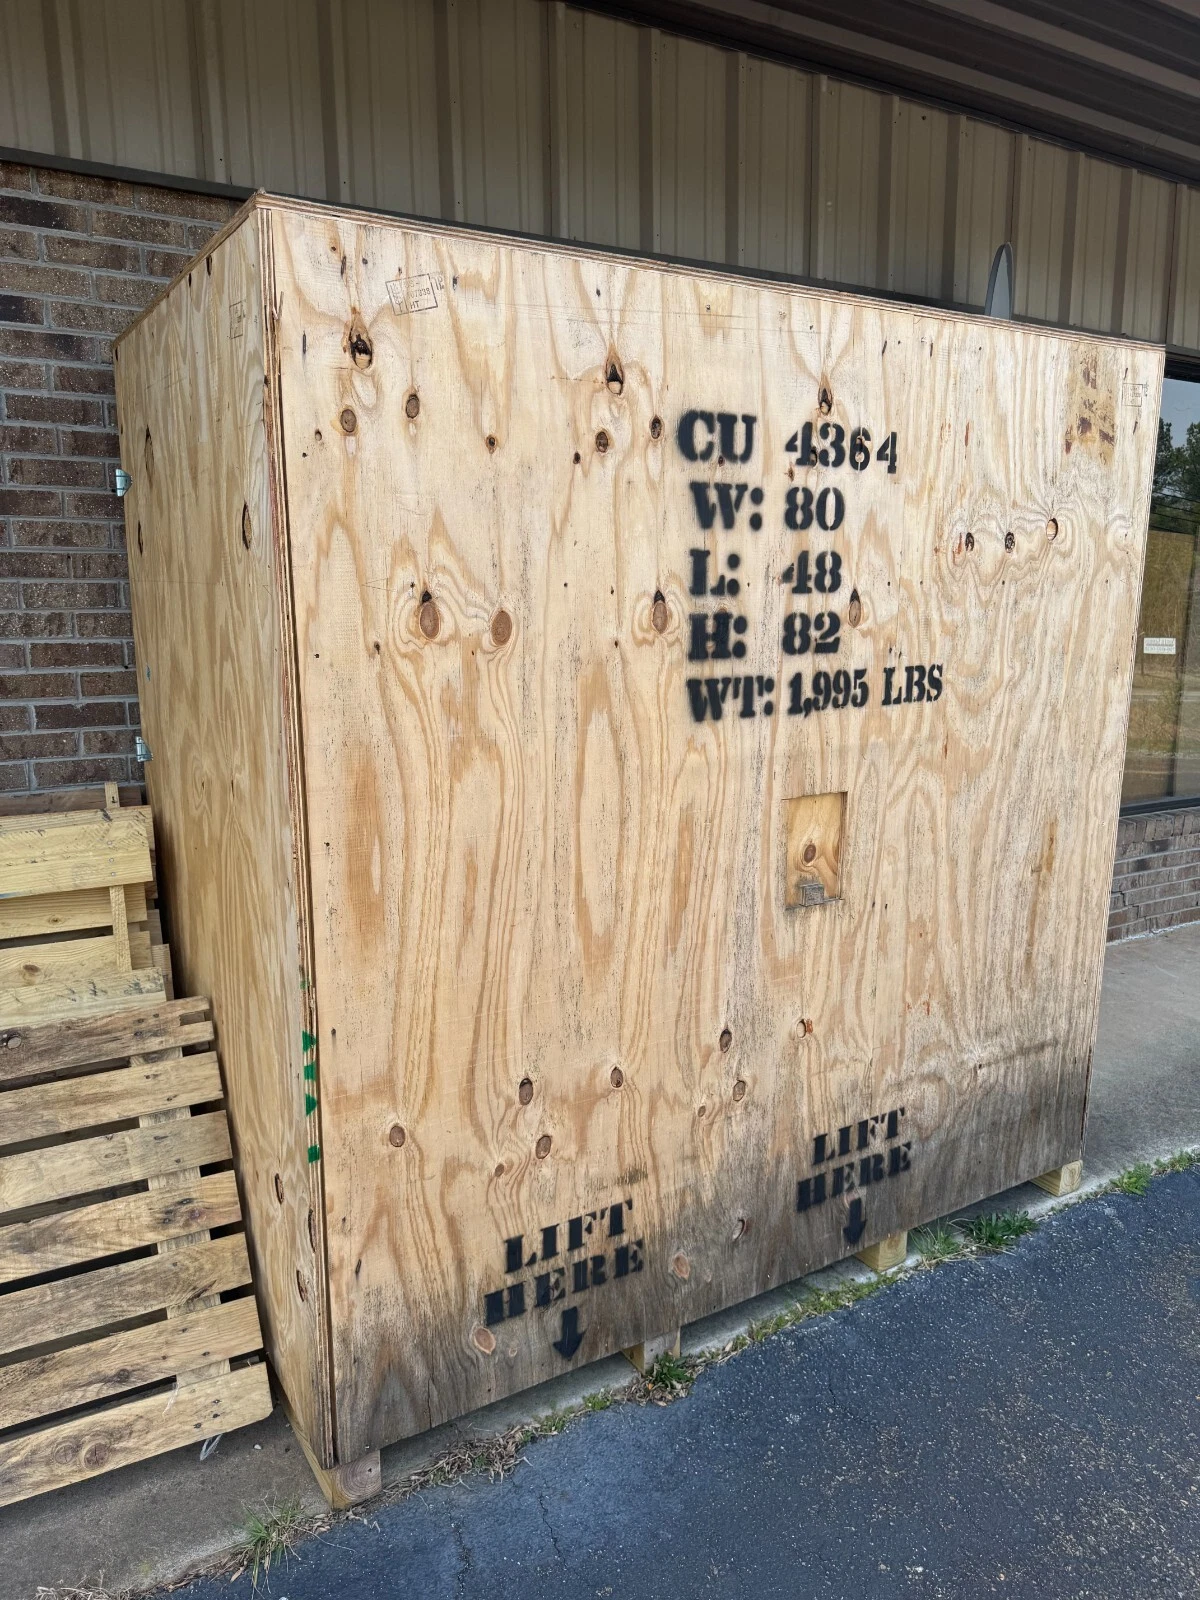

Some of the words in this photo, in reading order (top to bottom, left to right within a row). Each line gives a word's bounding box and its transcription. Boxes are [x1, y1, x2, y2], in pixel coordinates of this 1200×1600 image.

[677, 410, 757, 463] CU
[785, 422, 897, 474] 4364
[689, 481, 764, 531] W:
[784, 487, 845, 531] 80
[689, 548, 740, 596] L:
[781, 551, 842, 594] 48
[688, 612, 748, 662] H:
[782, 611, 841, 655] 82
[687, 675, 775, 722] WT:
[788, 668, 869, 718] 1,995
[882, 664, 944, 706] LBS
[813, 1107, 905, 1165] LIFT
[797, 1141, 911, 1212] HERE
[505, 1199, 633, 1273] LIFT
[485, 1239, 643, 1326] HERE
